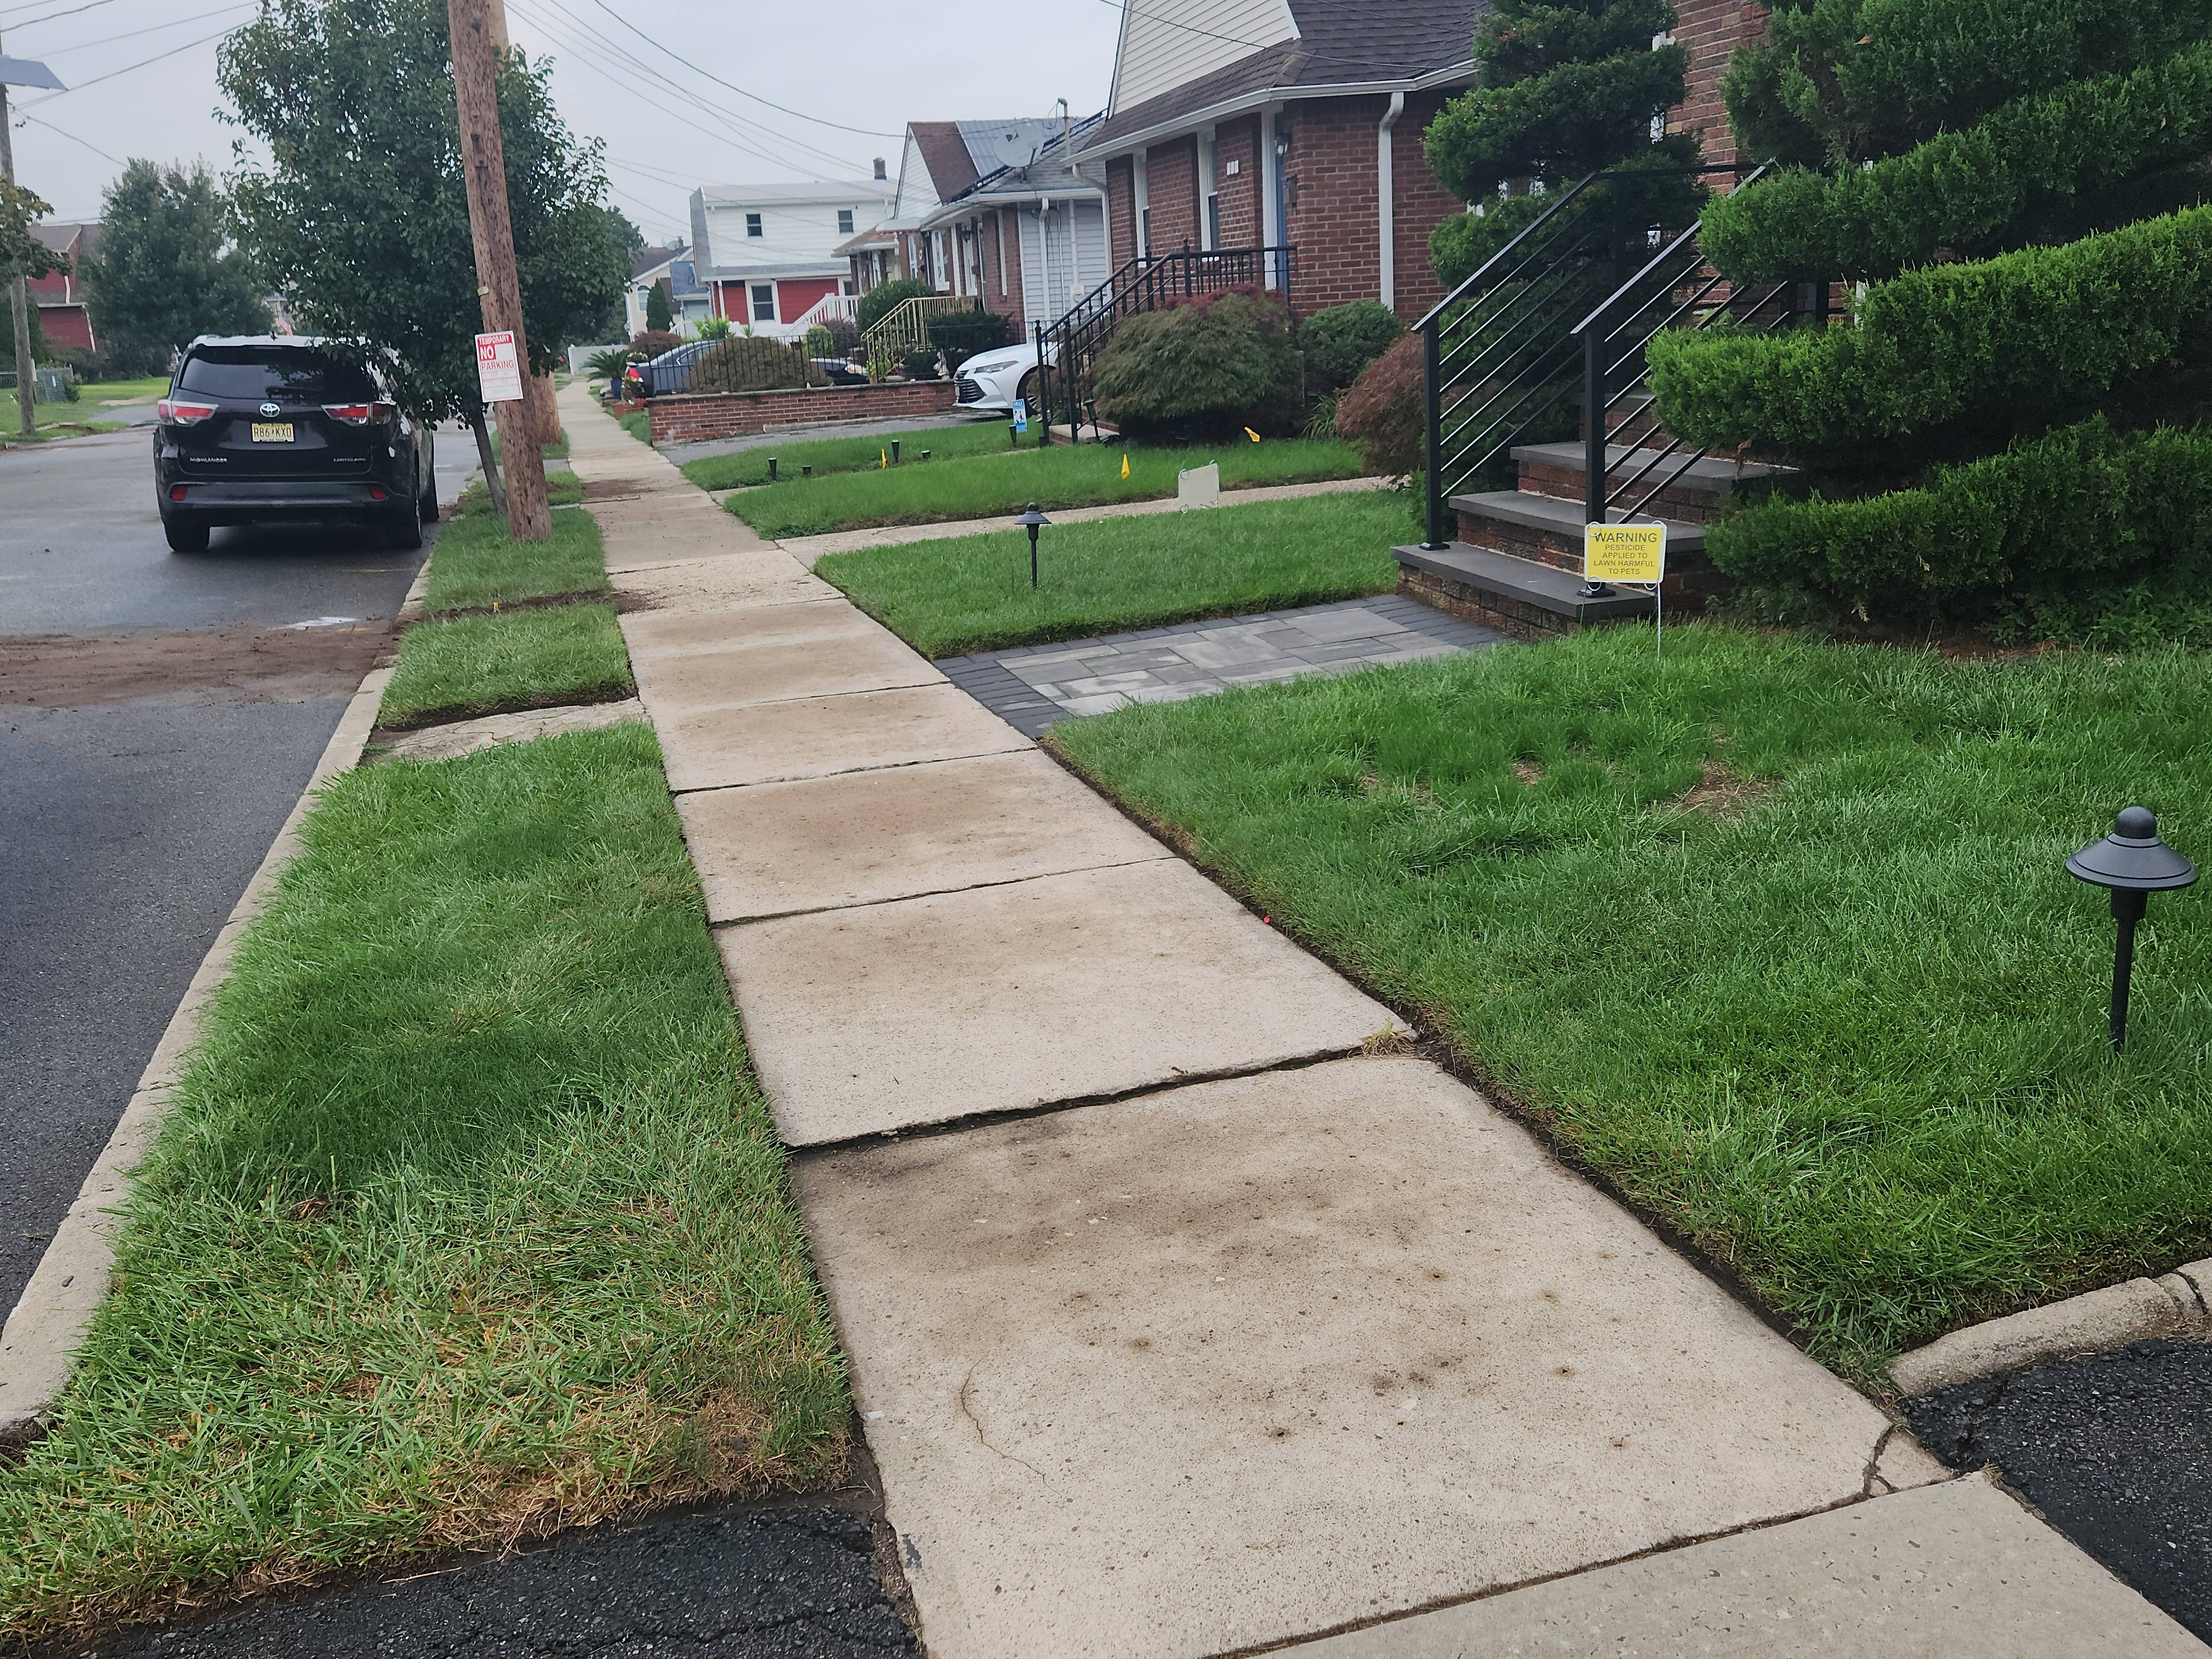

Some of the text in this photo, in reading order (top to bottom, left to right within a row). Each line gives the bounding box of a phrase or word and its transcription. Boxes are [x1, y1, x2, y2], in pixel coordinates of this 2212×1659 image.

[479, 335, 509, 345] TEMPORARY
[480, 345, 494, 360] NO
[481, 360, 514, 370] PARKING
[254, 428, 270, 437] R86
[1594, 533, 1657, 543] WARNING
